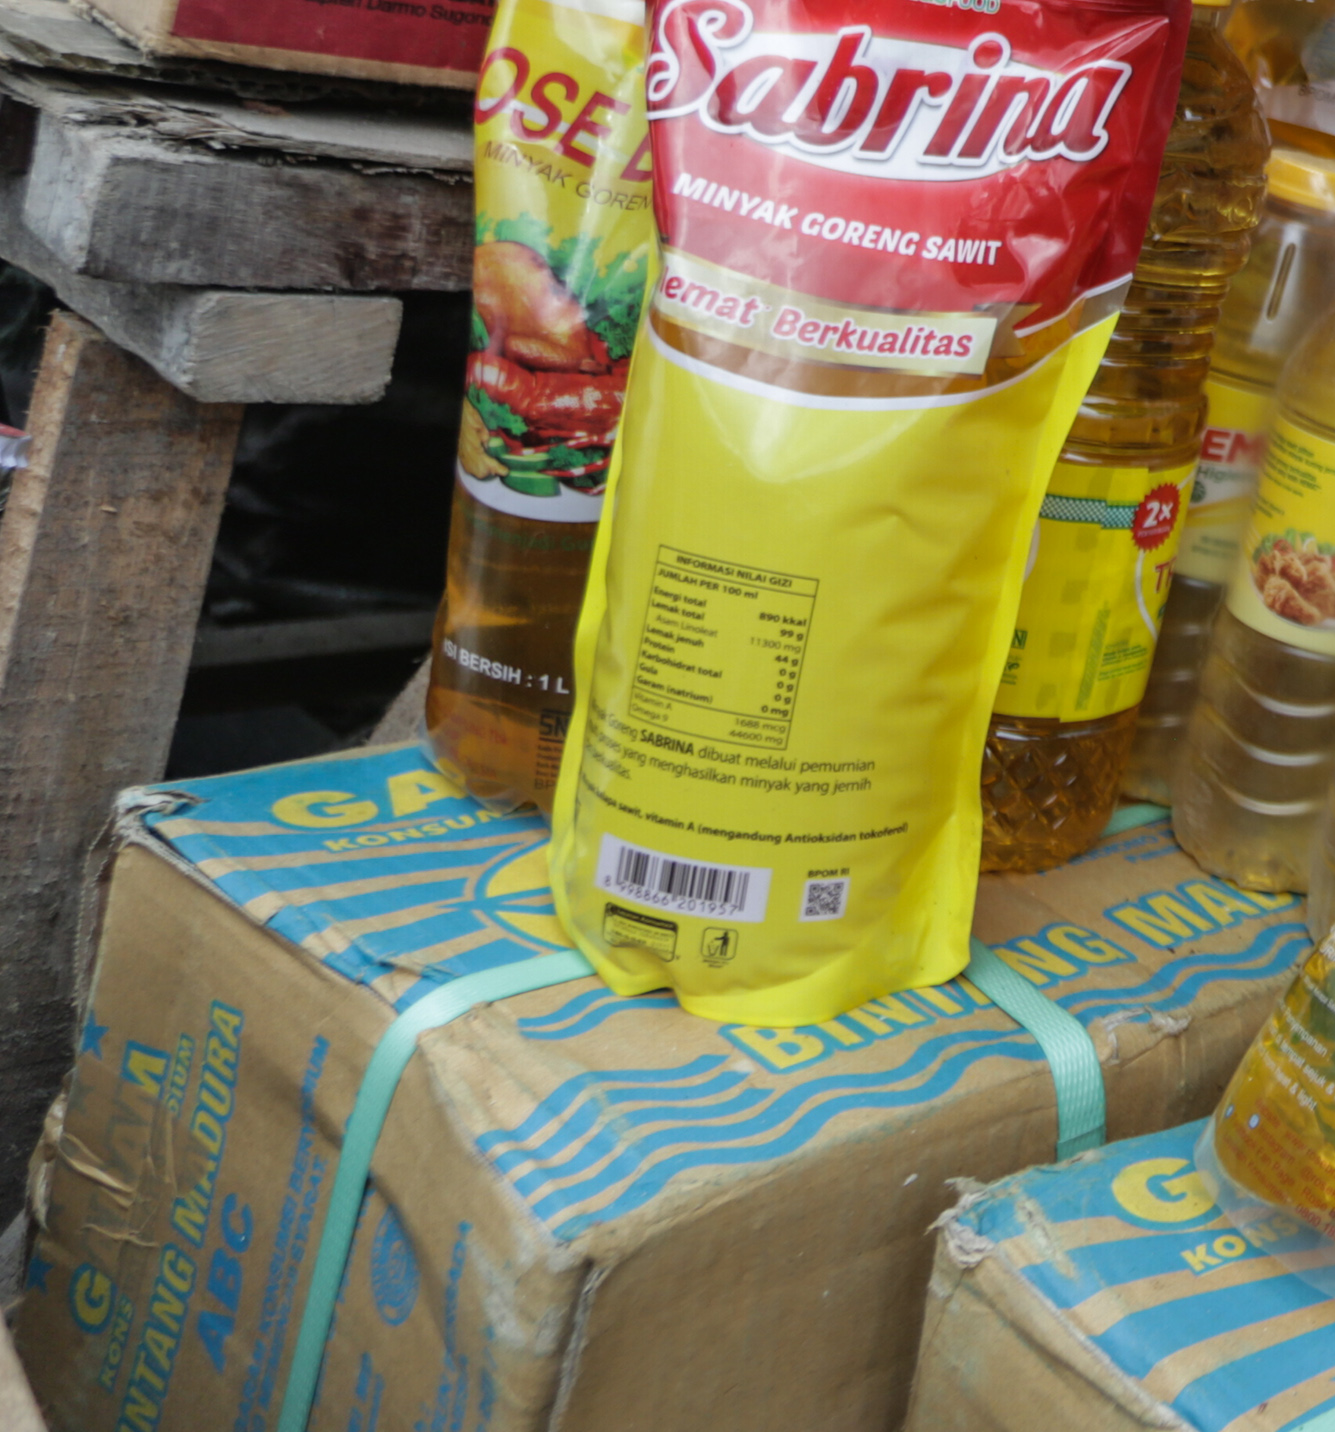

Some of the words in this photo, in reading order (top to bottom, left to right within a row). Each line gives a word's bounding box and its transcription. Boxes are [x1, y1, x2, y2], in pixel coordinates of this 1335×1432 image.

[475, 46, 632, 168] OSE
[484, 140, 574, 189] MINYAK
[672, 171, 798, 232] MINYAK
[801, 212, 920, 258] GORENG
[921, 236, 1002, 267] SAWIT
[772, 304, 975, 359] Berkualitas
[658, 568, 698, 586] JUMLAH
[699, 579, 719, 591] PER
[722, 584, 742, 596] 100
[744, 588, 758, 599] ml
[676, 555, 734, 577] INFORMASI
[737, 569, 767, 584] NILAI
[768, 575, 793, 589] GIZI
[651, 599, 679, 616] Lemak
[681, 606, 705, 621] total
[653, 586, 682, 603] Energi
[683, 594, 707, 608] total
[680, 621, 718, 639] Linoleat
[758, 611, 780, 624] 890
[782, 615, 807, 628] kkal
[780, 628, 794, 639] 99
[644, 637, 675, 654] Protein
[646, 625, 674, 641] Lemak
[676, 633, 704, 648] jenuh
[458, 647, 522, 685] BERSIH
[639, 663, 658, 677] Gula
[641, 650, 695, 673] Karbohidrat
[697, 665, 722, 680] total
[775, 654, 789, 665] 44
[634, 691, 664, 709] Vitamin
[637, 675, 665, 692] Garam
[667, 684, 713, 704] (natrium)
[639, 729, 695, 756] SABRINA
[697, 746, 741, 766] dibuat
[744, 755, 797, 772] melalui
[800, 759, 875, 774] pemurnian
[622, 746, 646, 766] yang
[649, 754, 737, 785] menghasilkan
[740, 773, 791, 793] minyak
[795, 779, 829, 796] yang
[833, 777, 872, 795] jernih
[645, 811, 685, 831] vitamin
[697, 822, 782, 846] (mengandung
[785, 831, 857, 844] Antioksidan
[859, 822, 909, 842] tokoferol)
[807, 868, 839, 879] BPOM
[1302, 1063, 1328, 1088] sejuk
[1301, 1186, 1329, 1213] Rose
[199, 1192, 254, 1372] ABC
